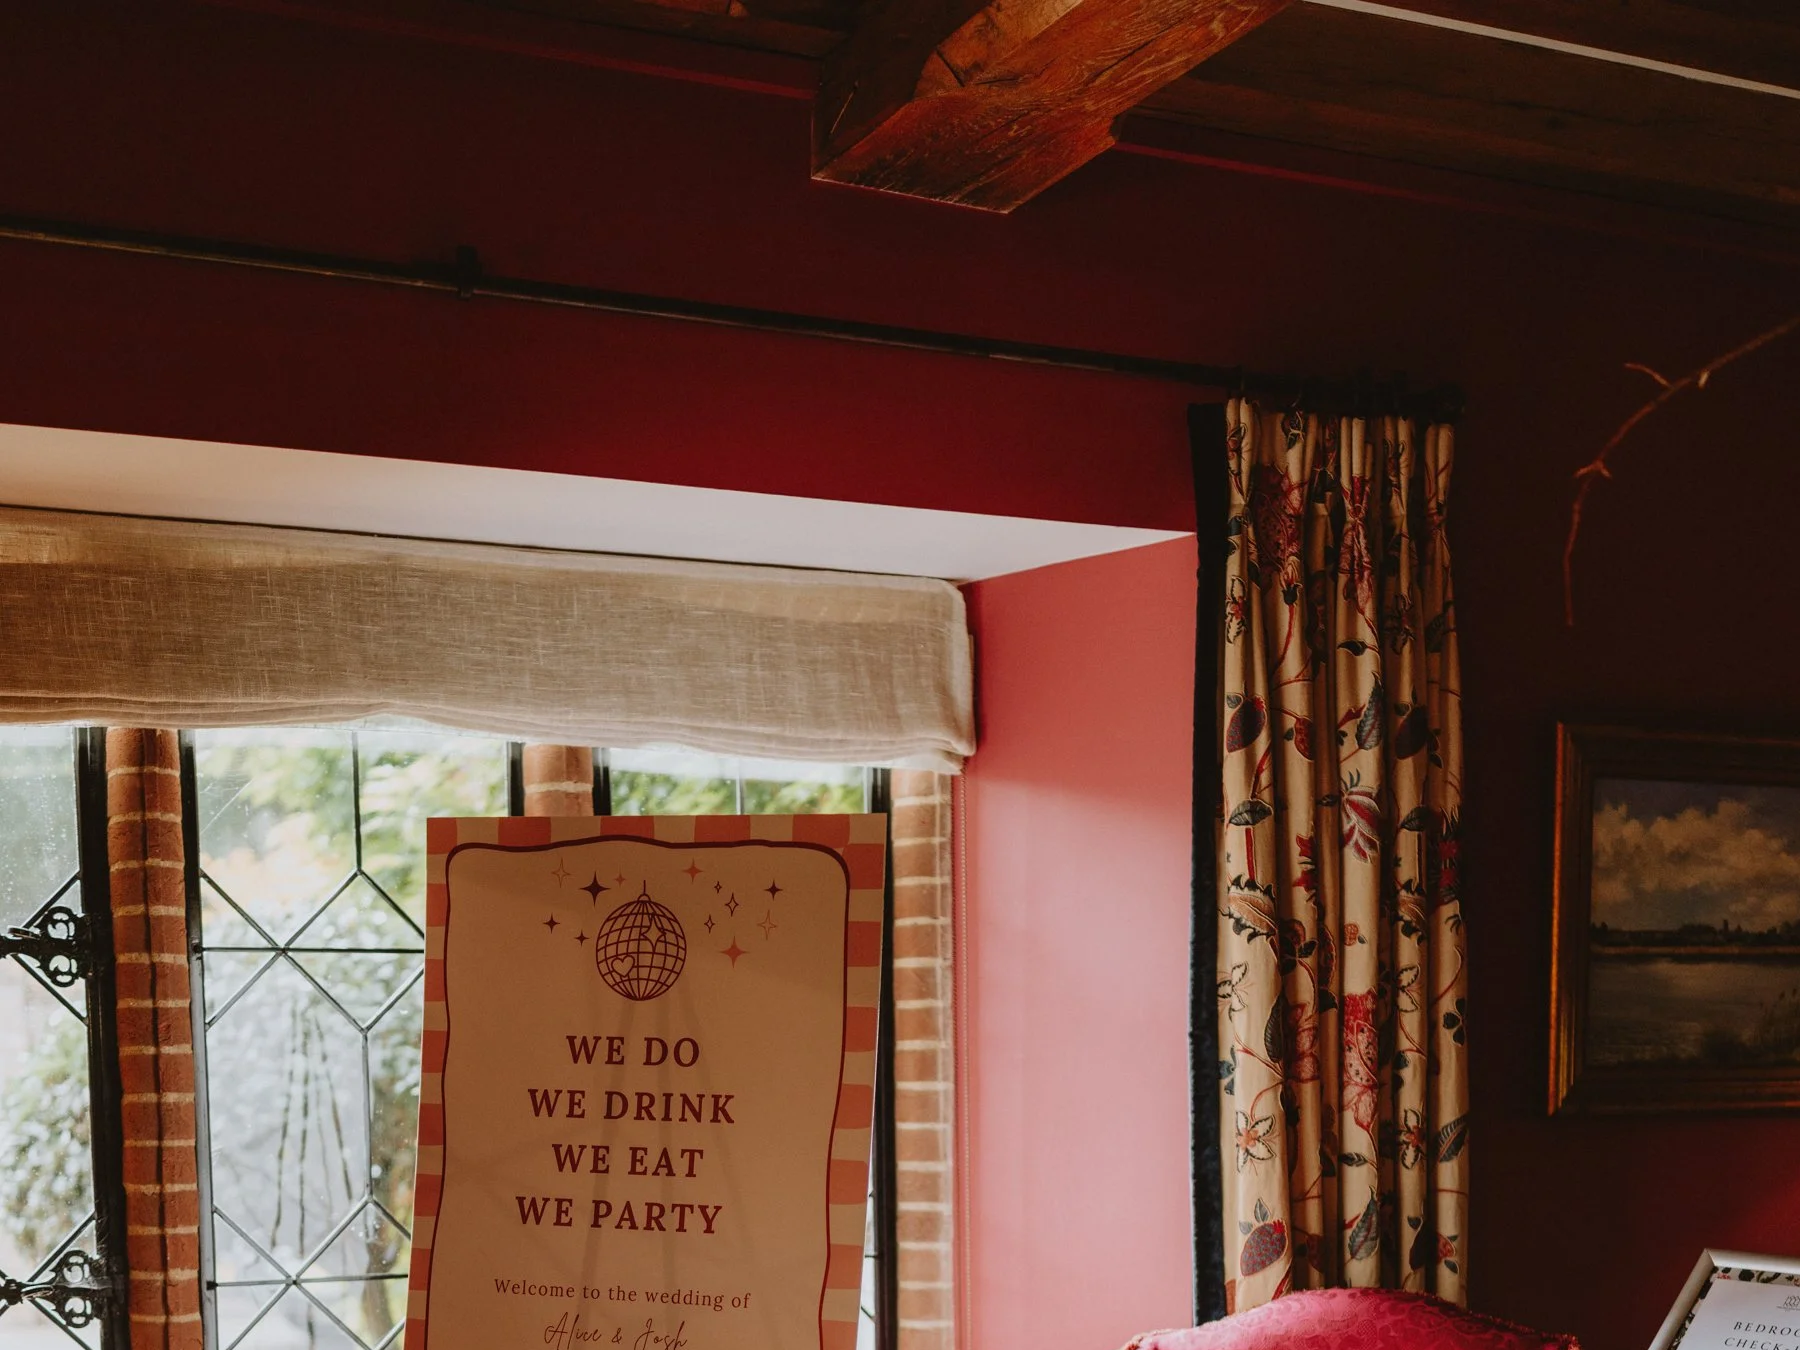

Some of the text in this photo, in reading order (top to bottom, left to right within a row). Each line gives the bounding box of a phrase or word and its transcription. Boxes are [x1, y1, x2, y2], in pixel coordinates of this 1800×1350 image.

[566, 1035, 700, 1068] WE DO
[527, 1088, 735, 1124] WE DRINK
[551, 1143, 704, 1178] WE EAT
[515, 1196, 722, 1234] WE PARTY
[494, 1278, 751, 1312] Welcome to the wedding of
[611, 1327, 622, 1344] &
